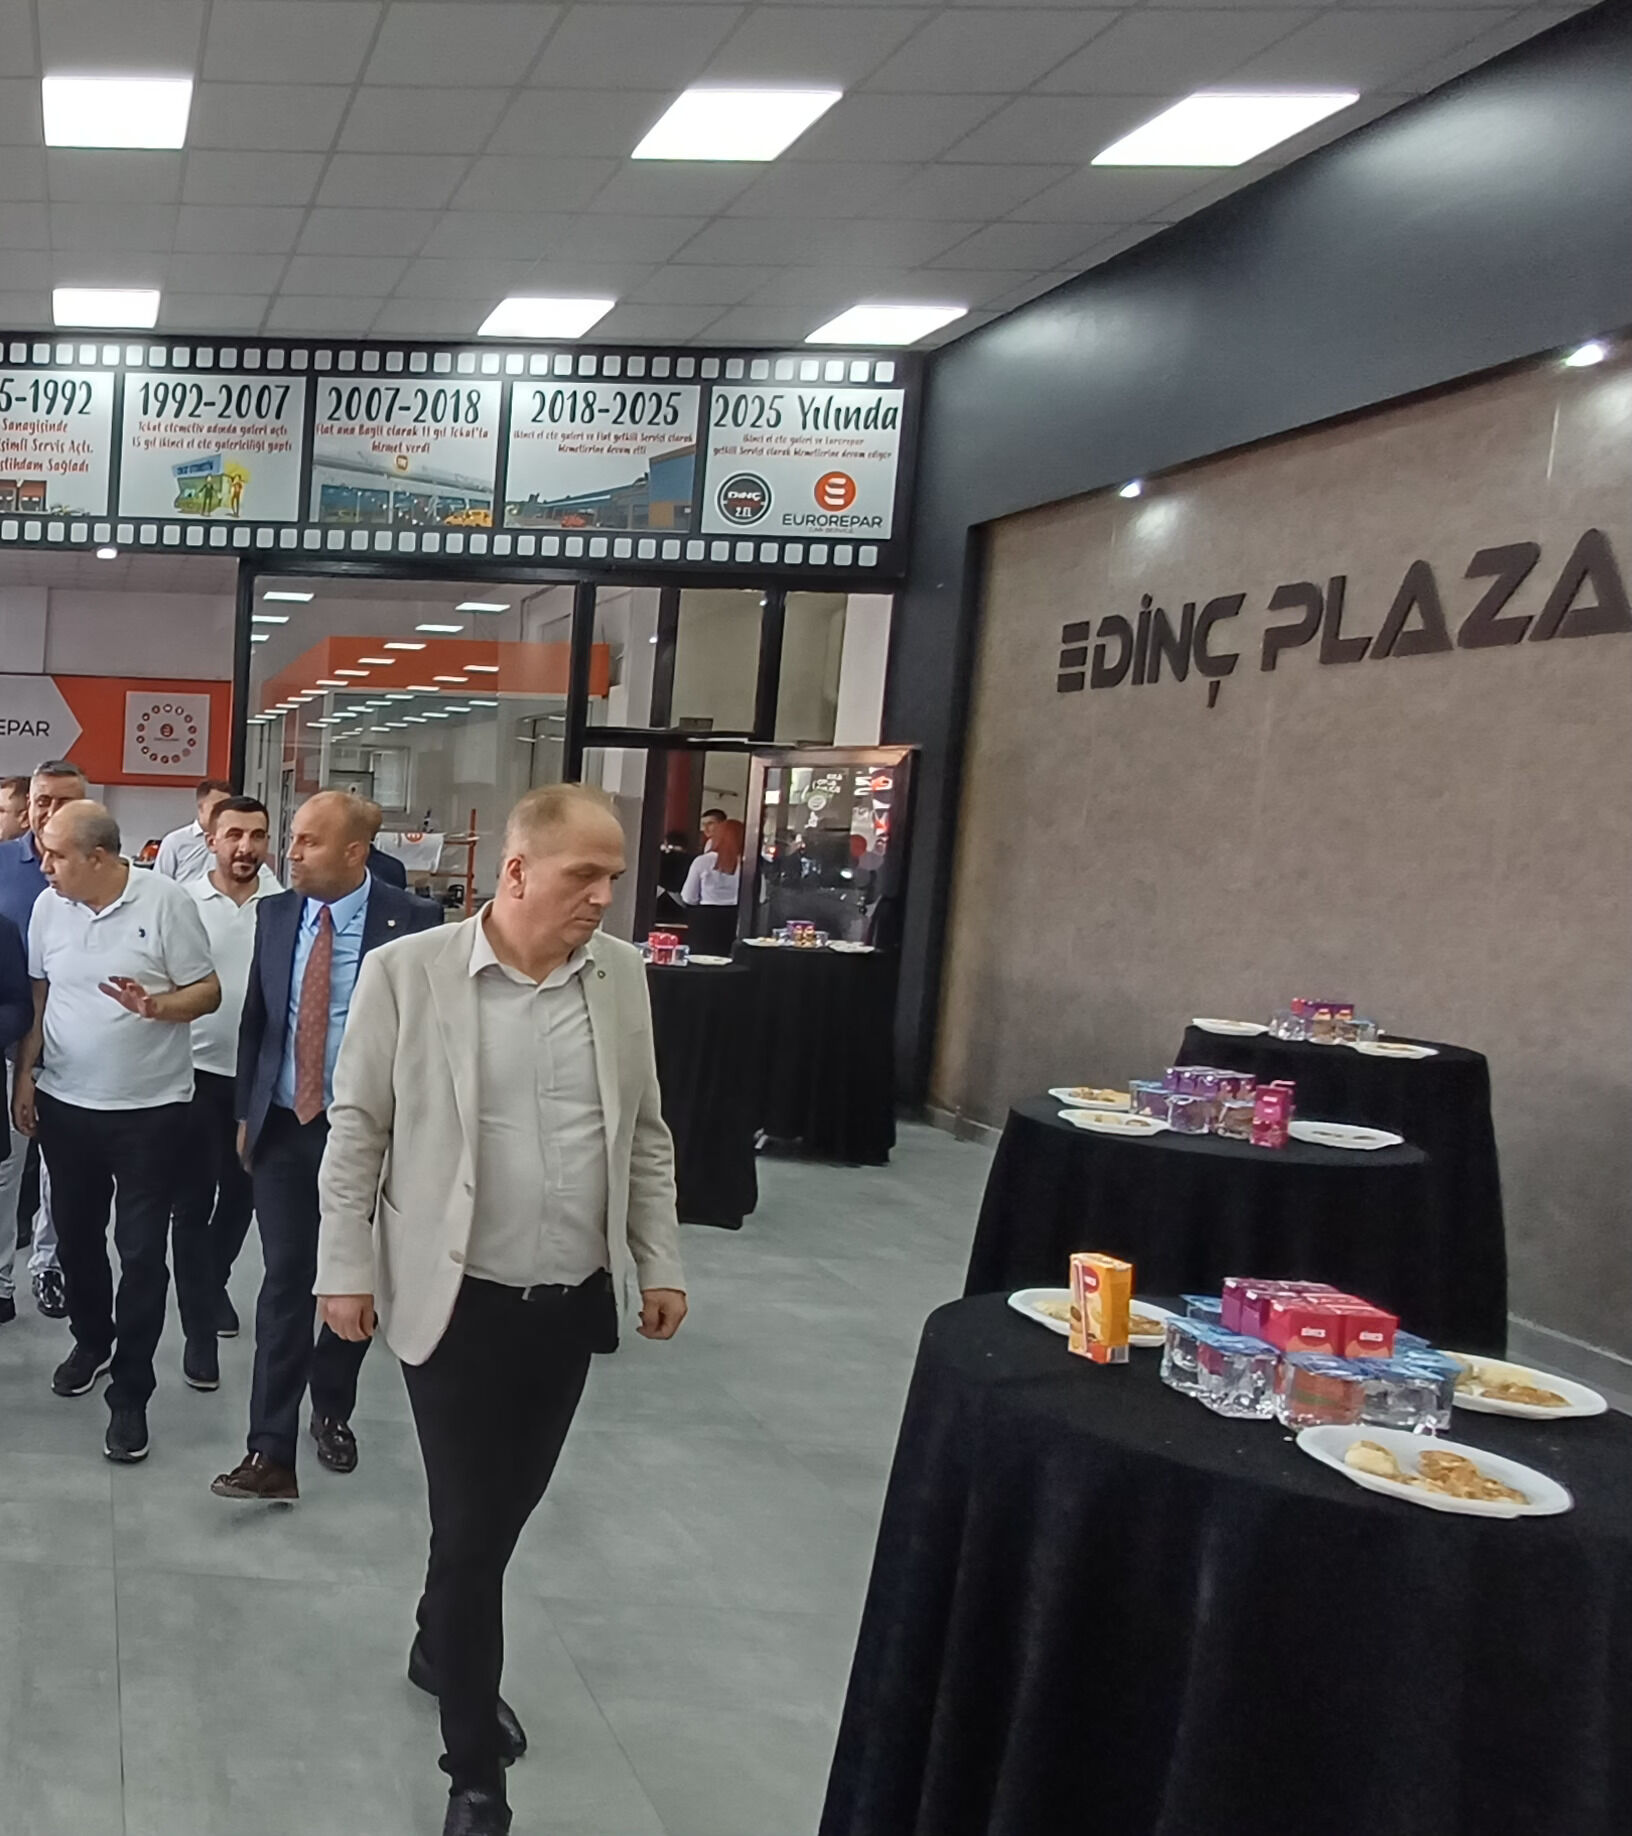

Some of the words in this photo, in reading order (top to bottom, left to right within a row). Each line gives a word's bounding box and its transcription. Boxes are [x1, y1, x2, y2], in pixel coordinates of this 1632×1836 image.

[140, 382, 290, 420] 1992-2007
[327, 387, 480, 424] 2007-2018
[531, 390, 681, 426] 2018-2025
[713, 394, 784, 428] 2025
[798, 395, 898, 431] Yılında
[32, 439, 64, 453] Servis
[48, 459, 88, 475] Sağladı
[782, 513, 883, 528] EUROREPAR
[1261, 527, 1632, 672] PLAZA
